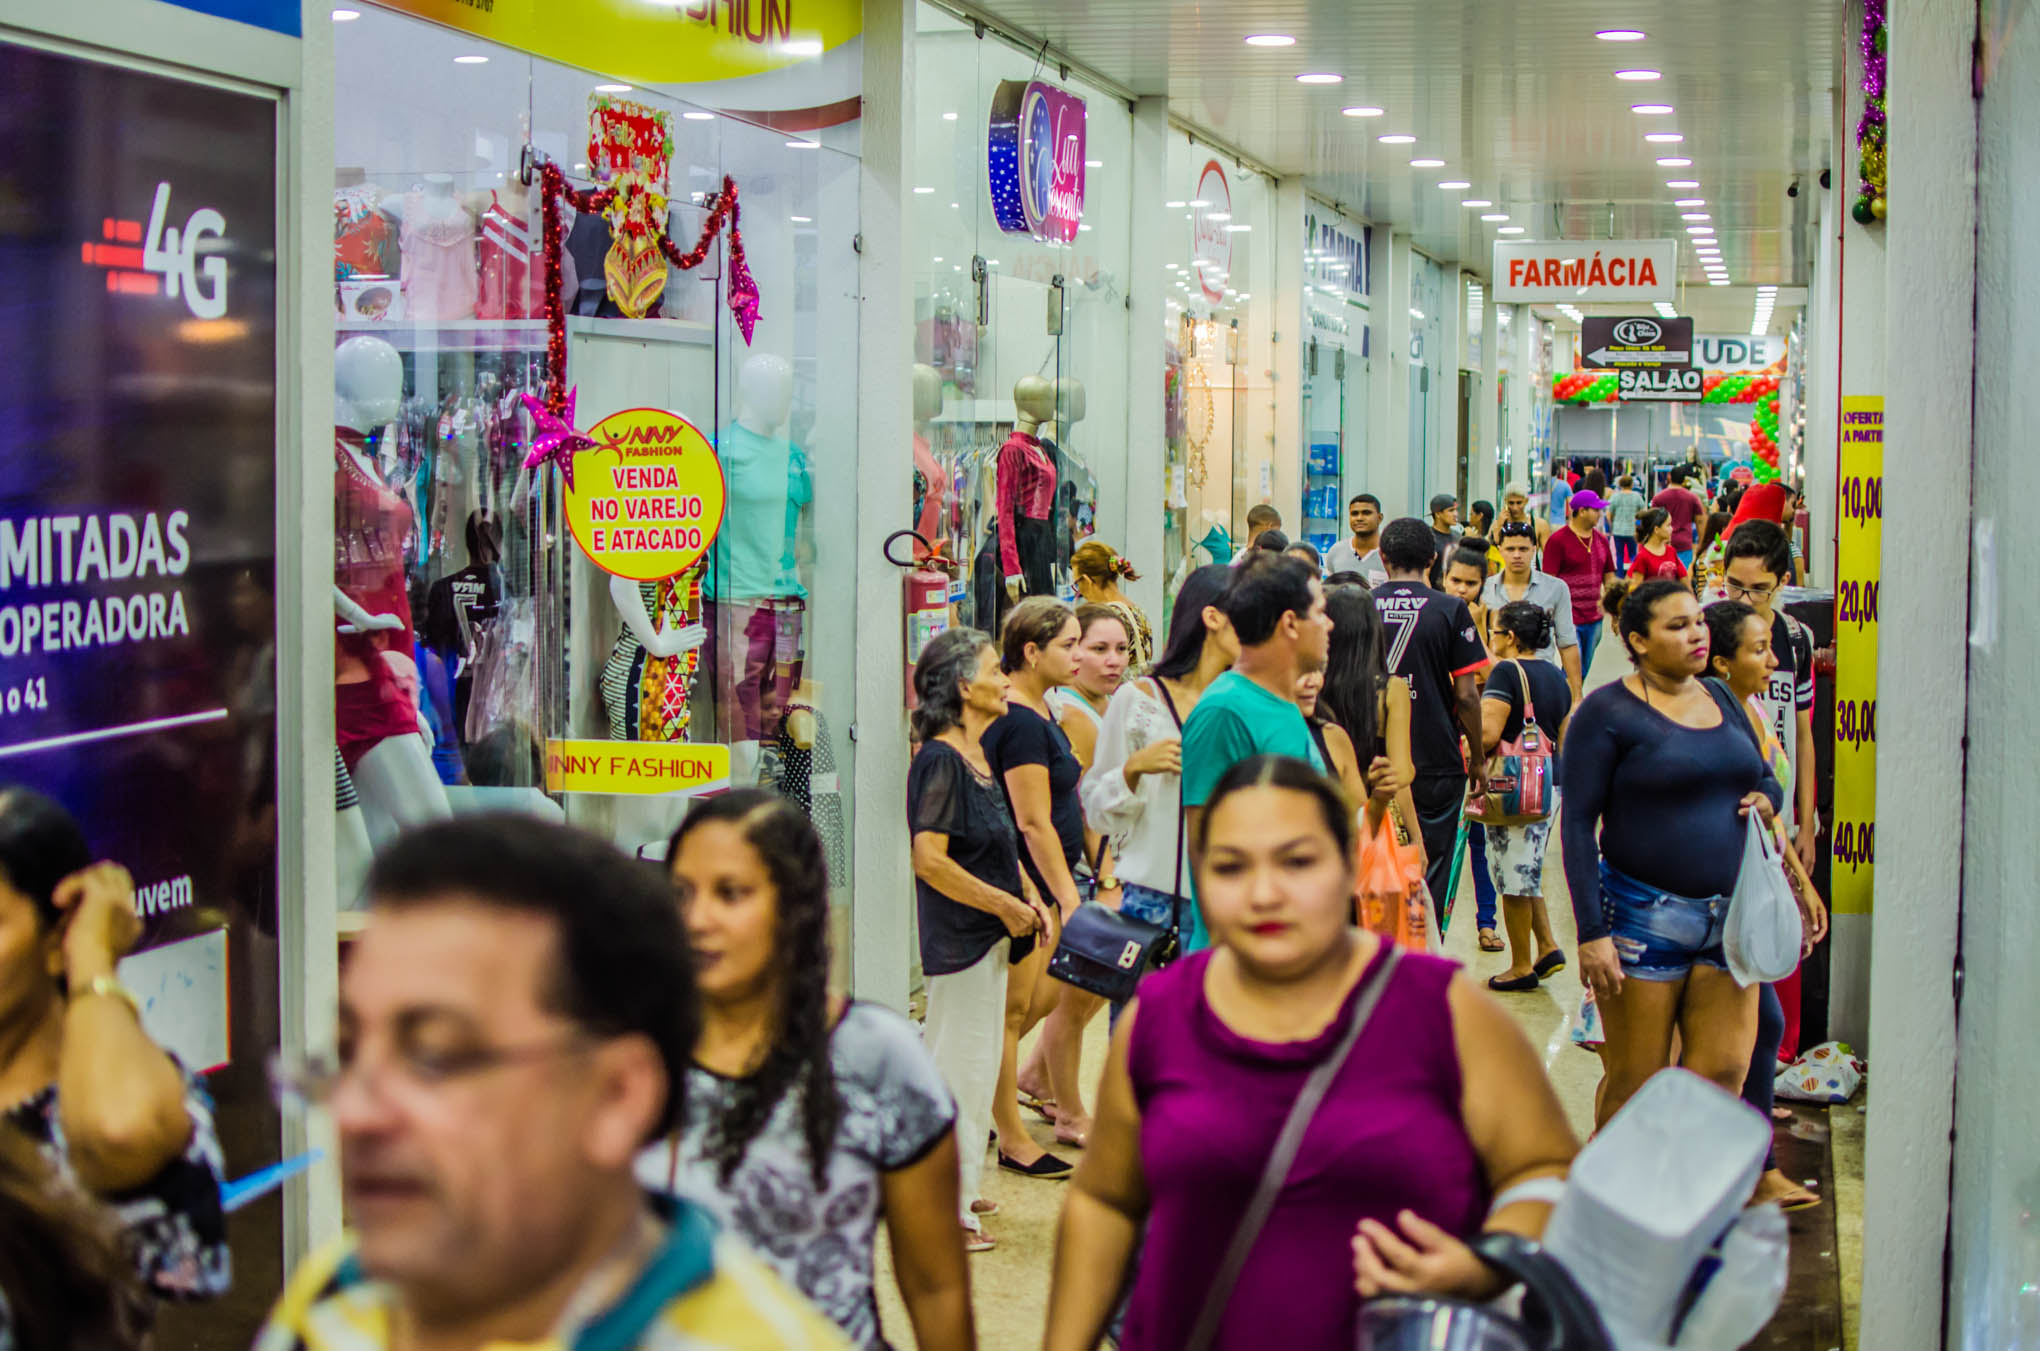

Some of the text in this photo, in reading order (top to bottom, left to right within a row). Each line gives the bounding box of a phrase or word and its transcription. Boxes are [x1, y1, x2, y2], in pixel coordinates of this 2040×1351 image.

[143, 181, 227, 318] 4G
[1509, 251, 1658, 287] FARMÁCIA
[1697, 338, 1766, 365] UDE
[1619, 369, 1700, 390] SALÃO
[1843, 429, 1883, 443] A PARTI
[625, 446, 683, 457] FASHION
[612, 466, 679, 489] VENDA
[591, 496, 702, 521] NO VAREJO
[593, 527, 702, 551] E ATACADO
[1376, 597, 1429, 610] MRV
[0, 590, 190, 657] OPERADORA
[1383, 610, 1419, 674] 7
[24, 676, 48, 710] 41
[610, 756, 713, 779] FASHION
[1833, 821, 1875, 874] 40,00
